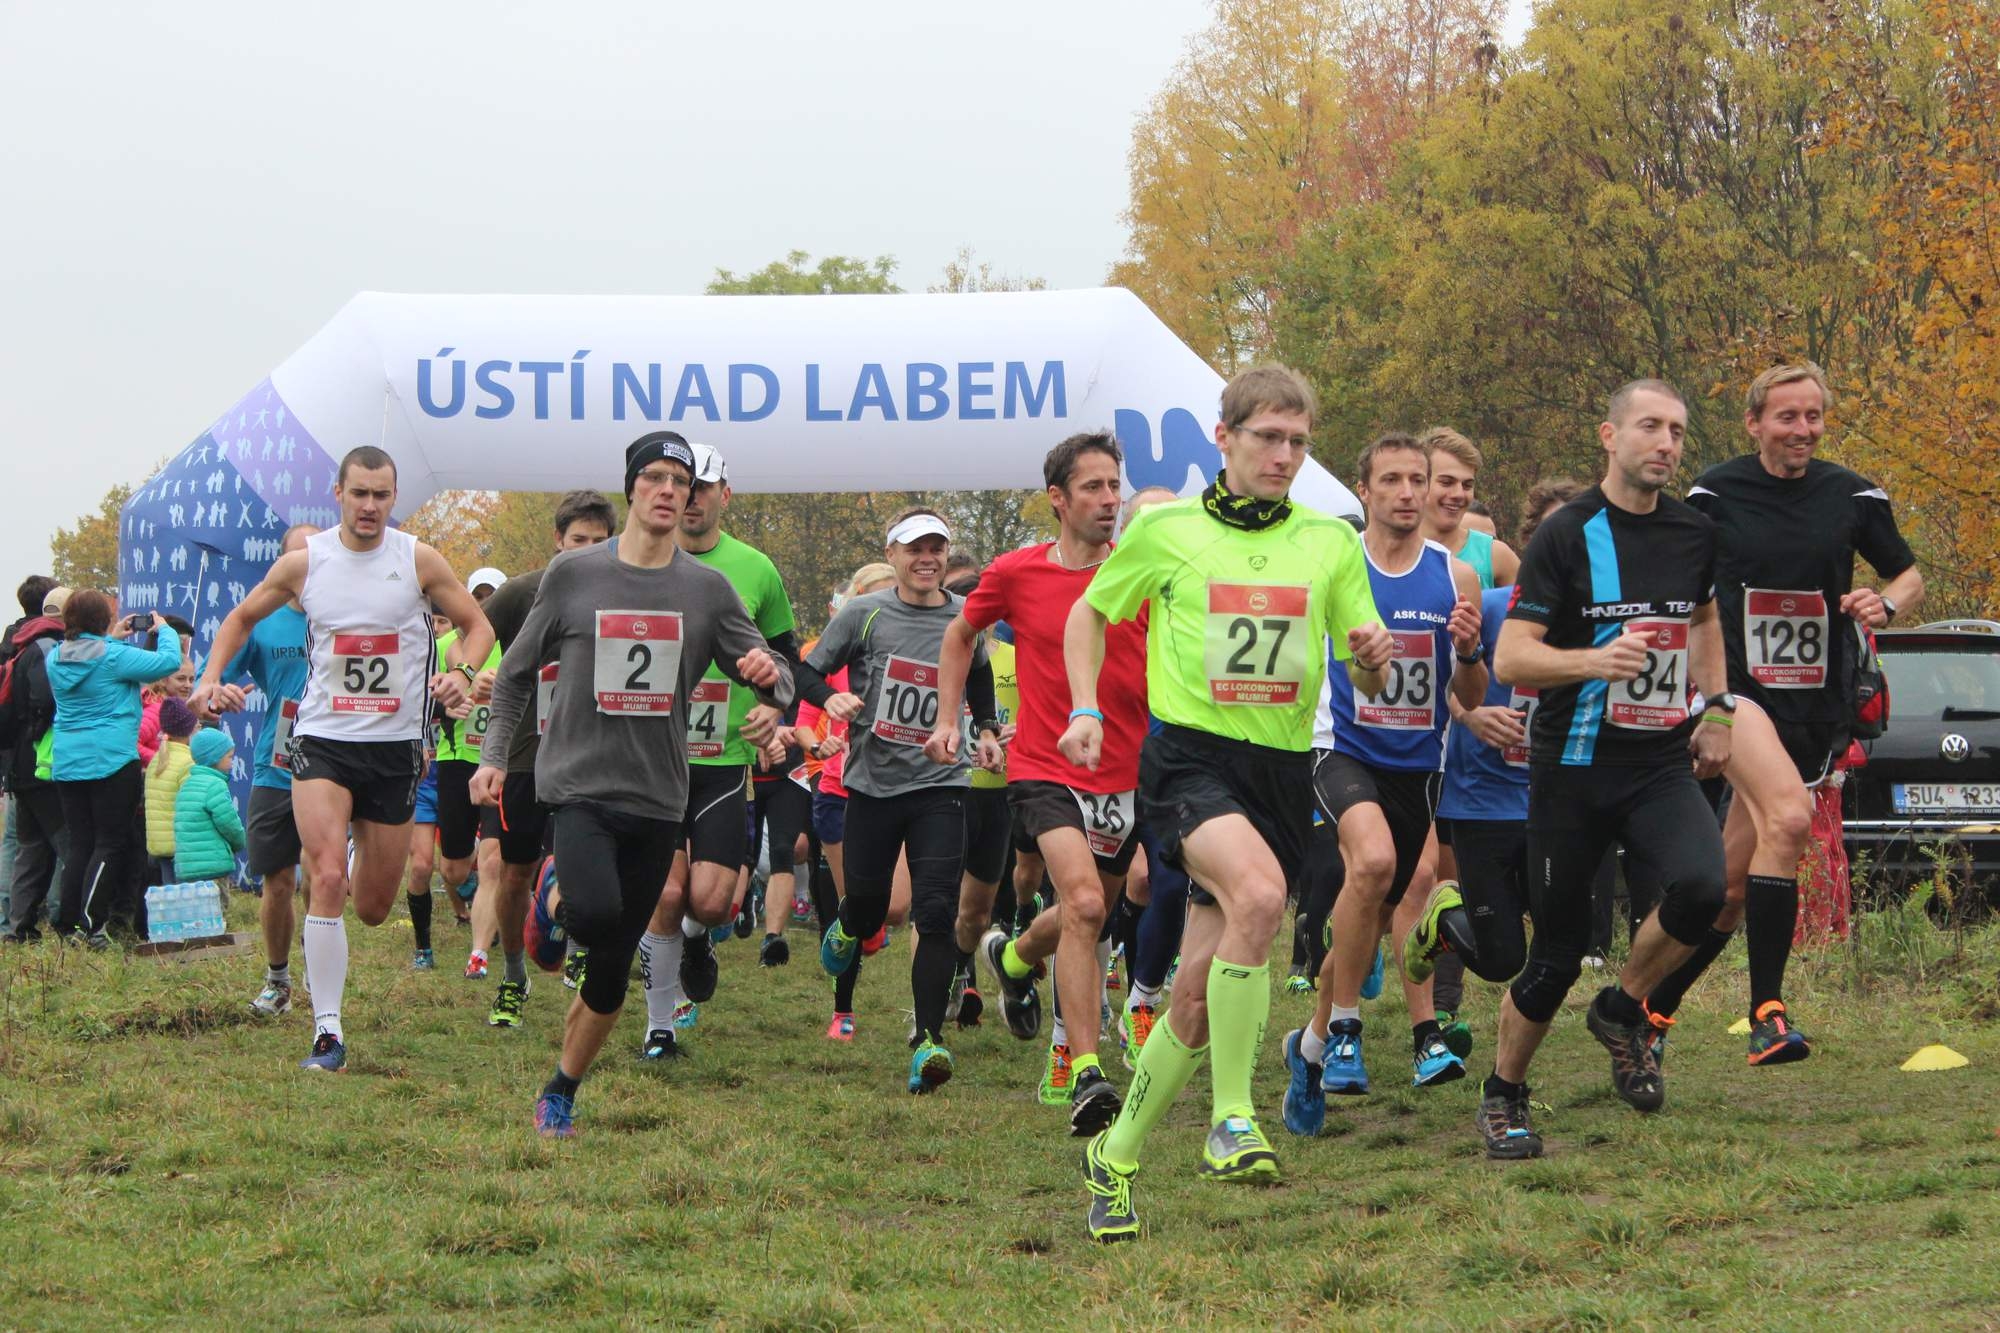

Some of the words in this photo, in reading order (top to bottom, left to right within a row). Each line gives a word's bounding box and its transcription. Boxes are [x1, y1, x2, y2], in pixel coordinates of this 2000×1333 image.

[417, 347, 591, 419] ÚSTÍ
[611, 363, 780, 421] NAD
[805, 360, 1068, 421] LABEM
[1393, 610, 1417, 620] ASK
[1419, 611, 1447, 624] Děčín
[1582, 602, 1657, 618] HNIZDIL
[1665, 601, 1696, 613] TEA
[1225, 617, 1291, 676] 27
[1752, 620, 1822, 665] 128
[343, 657, 390, 694] 52
[625, 643, 652, 690] 2
[1627, 651, 1678, 704] 84
[1215, 682, 1229, 692] EC
[1231, 683, 1293, 694] LOKOMOTIVA
[1236, 692, 1271, 702] MUMIE
[1367, 660, 1431, 706] 03
[349, 698, 396, 706] LOKOMOTIVA
[603, 694, 615, 702] EC
[618, 695, 669, 703] LOKOMOTIVA
[623, 703, 651, 711] MUMIE
[886, 683, 939, 728] 100
[1617, 705, 1629, 714] EC
[474, 706, 490, 734] 8
[1376, 710, 1427, 718] LOKOMOTIVA
[1127, 1064, 1152, 1121] FORCE
